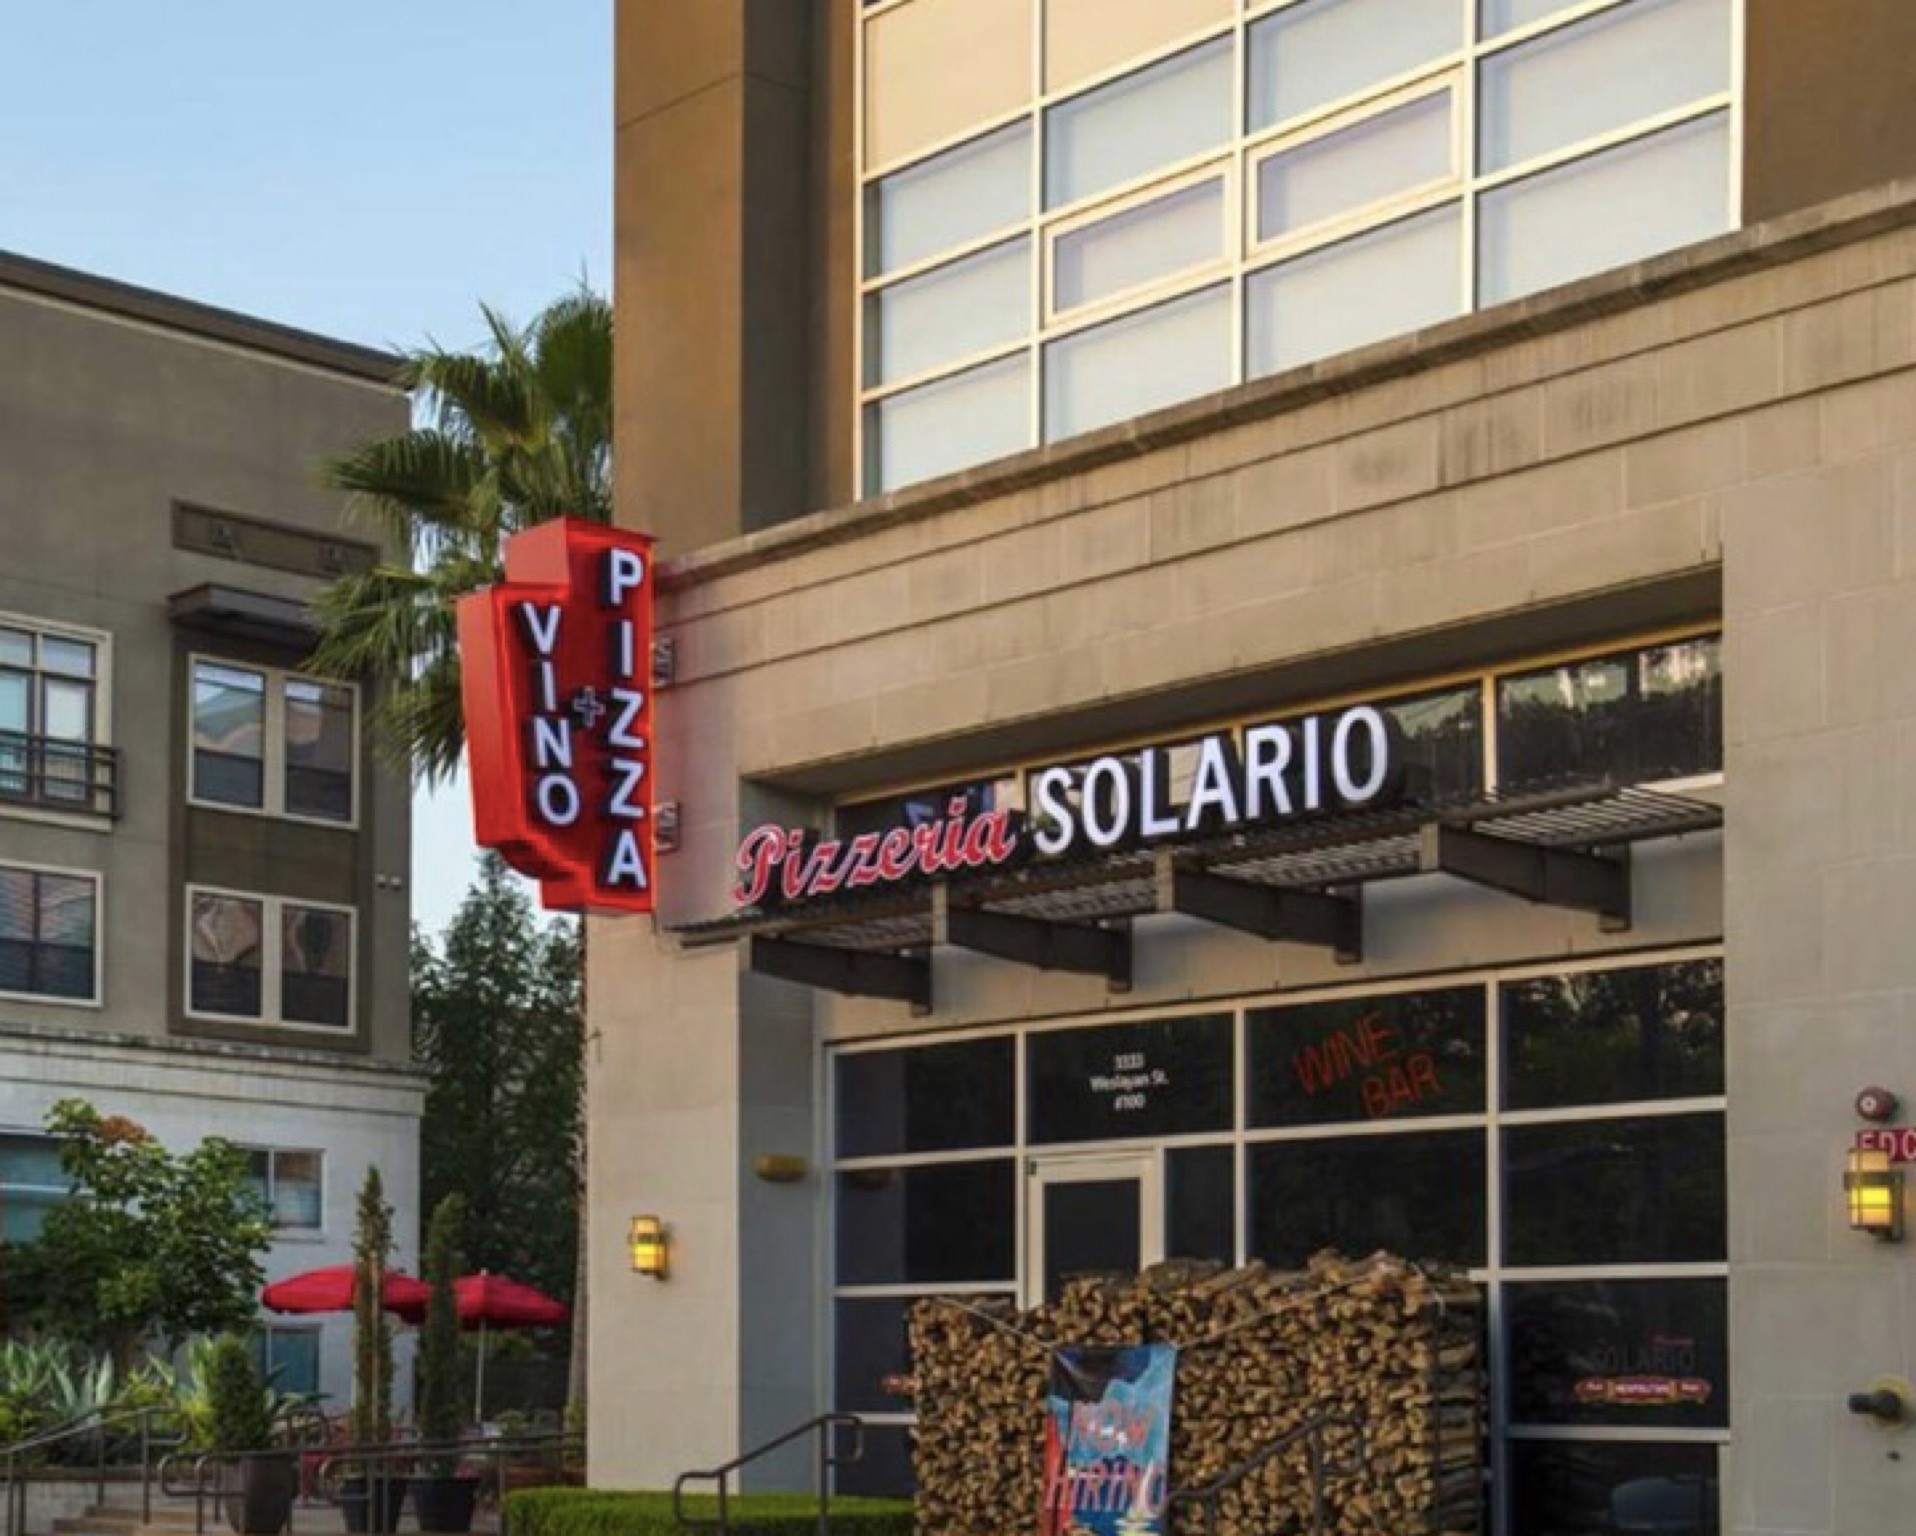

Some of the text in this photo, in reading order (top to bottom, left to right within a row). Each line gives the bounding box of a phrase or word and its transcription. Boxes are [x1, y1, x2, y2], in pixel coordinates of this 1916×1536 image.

[521, 601, 581, 826] VINO
[604, 548, 647, 888] PIZZA
[732, 705, 1389, 907] Pizzeria SOLARIO
[1292, 1012, 1397, 1096] WINE
[1360, 1051, 1442, 1118] BAR
